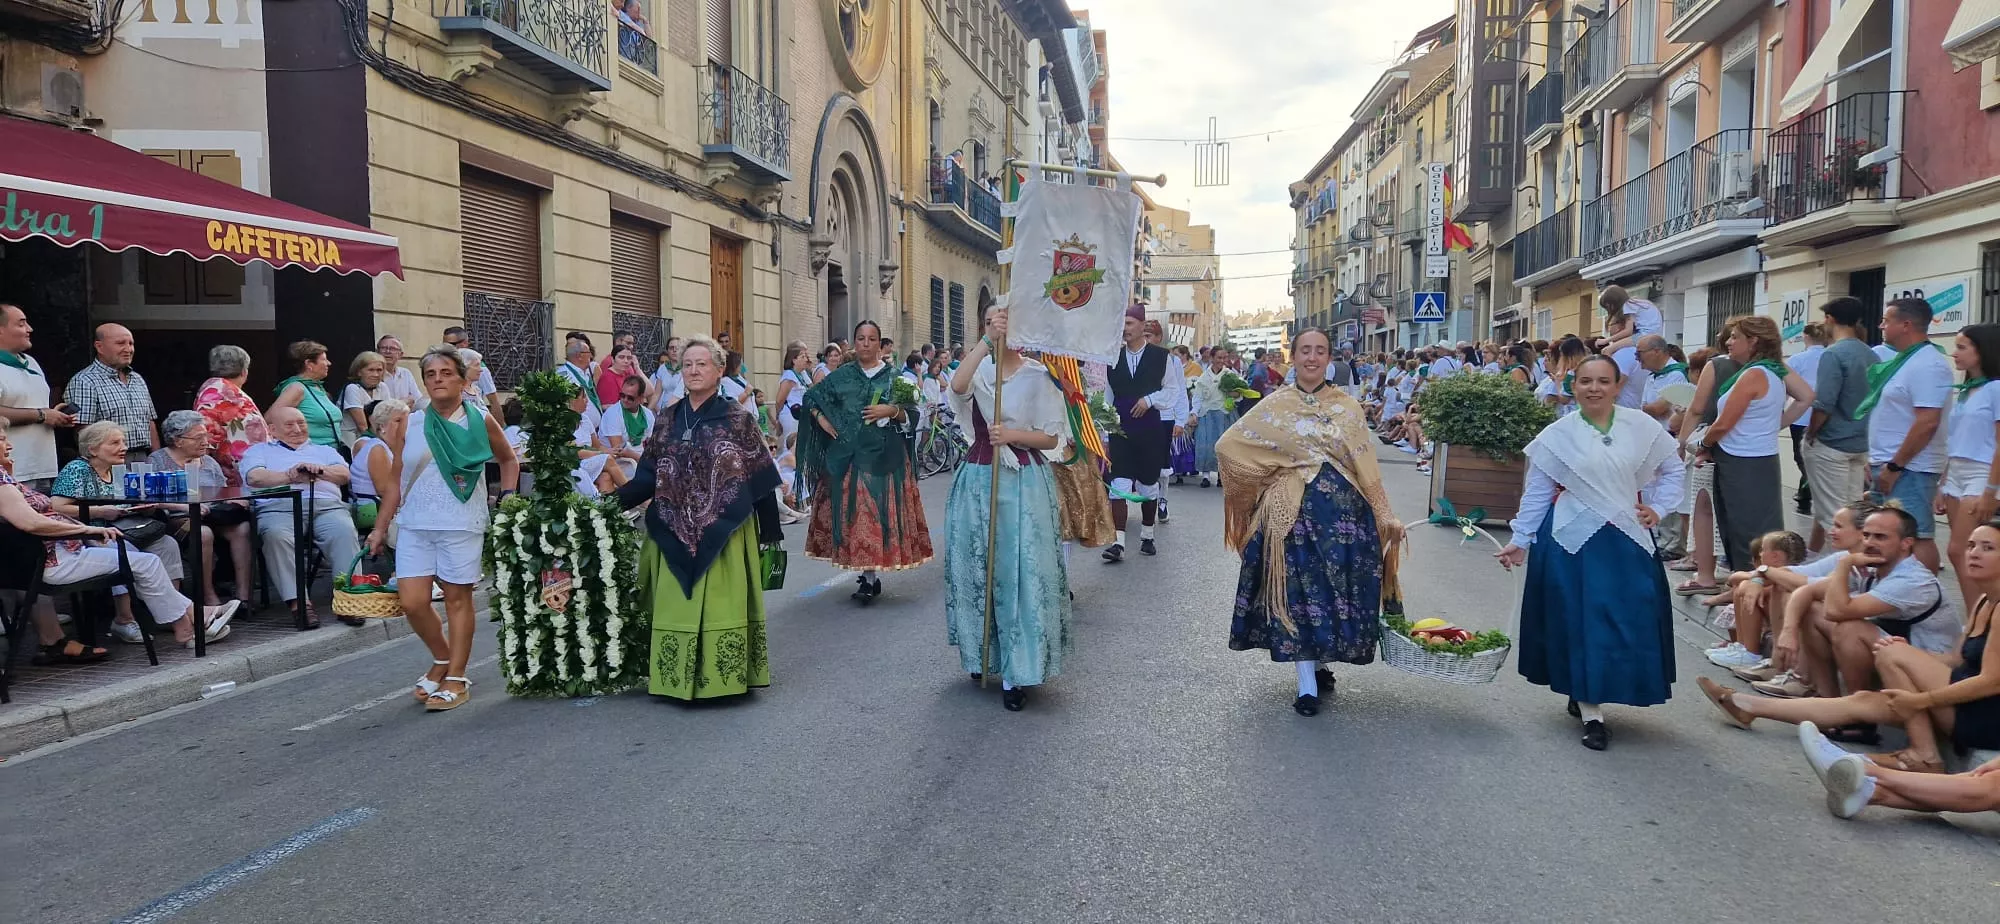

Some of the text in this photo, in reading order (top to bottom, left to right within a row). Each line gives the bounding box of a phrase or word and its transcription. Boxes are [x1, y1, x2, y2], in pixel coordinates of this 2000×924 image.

[1431, 165, 1442, 203] Gastro
[88, 203, 104, 240] 1
[206, 220, 342, 266] CAFETERIA
[1782, 299, 1805, 328] APP
[1943, 310, 1962, 323] .com
